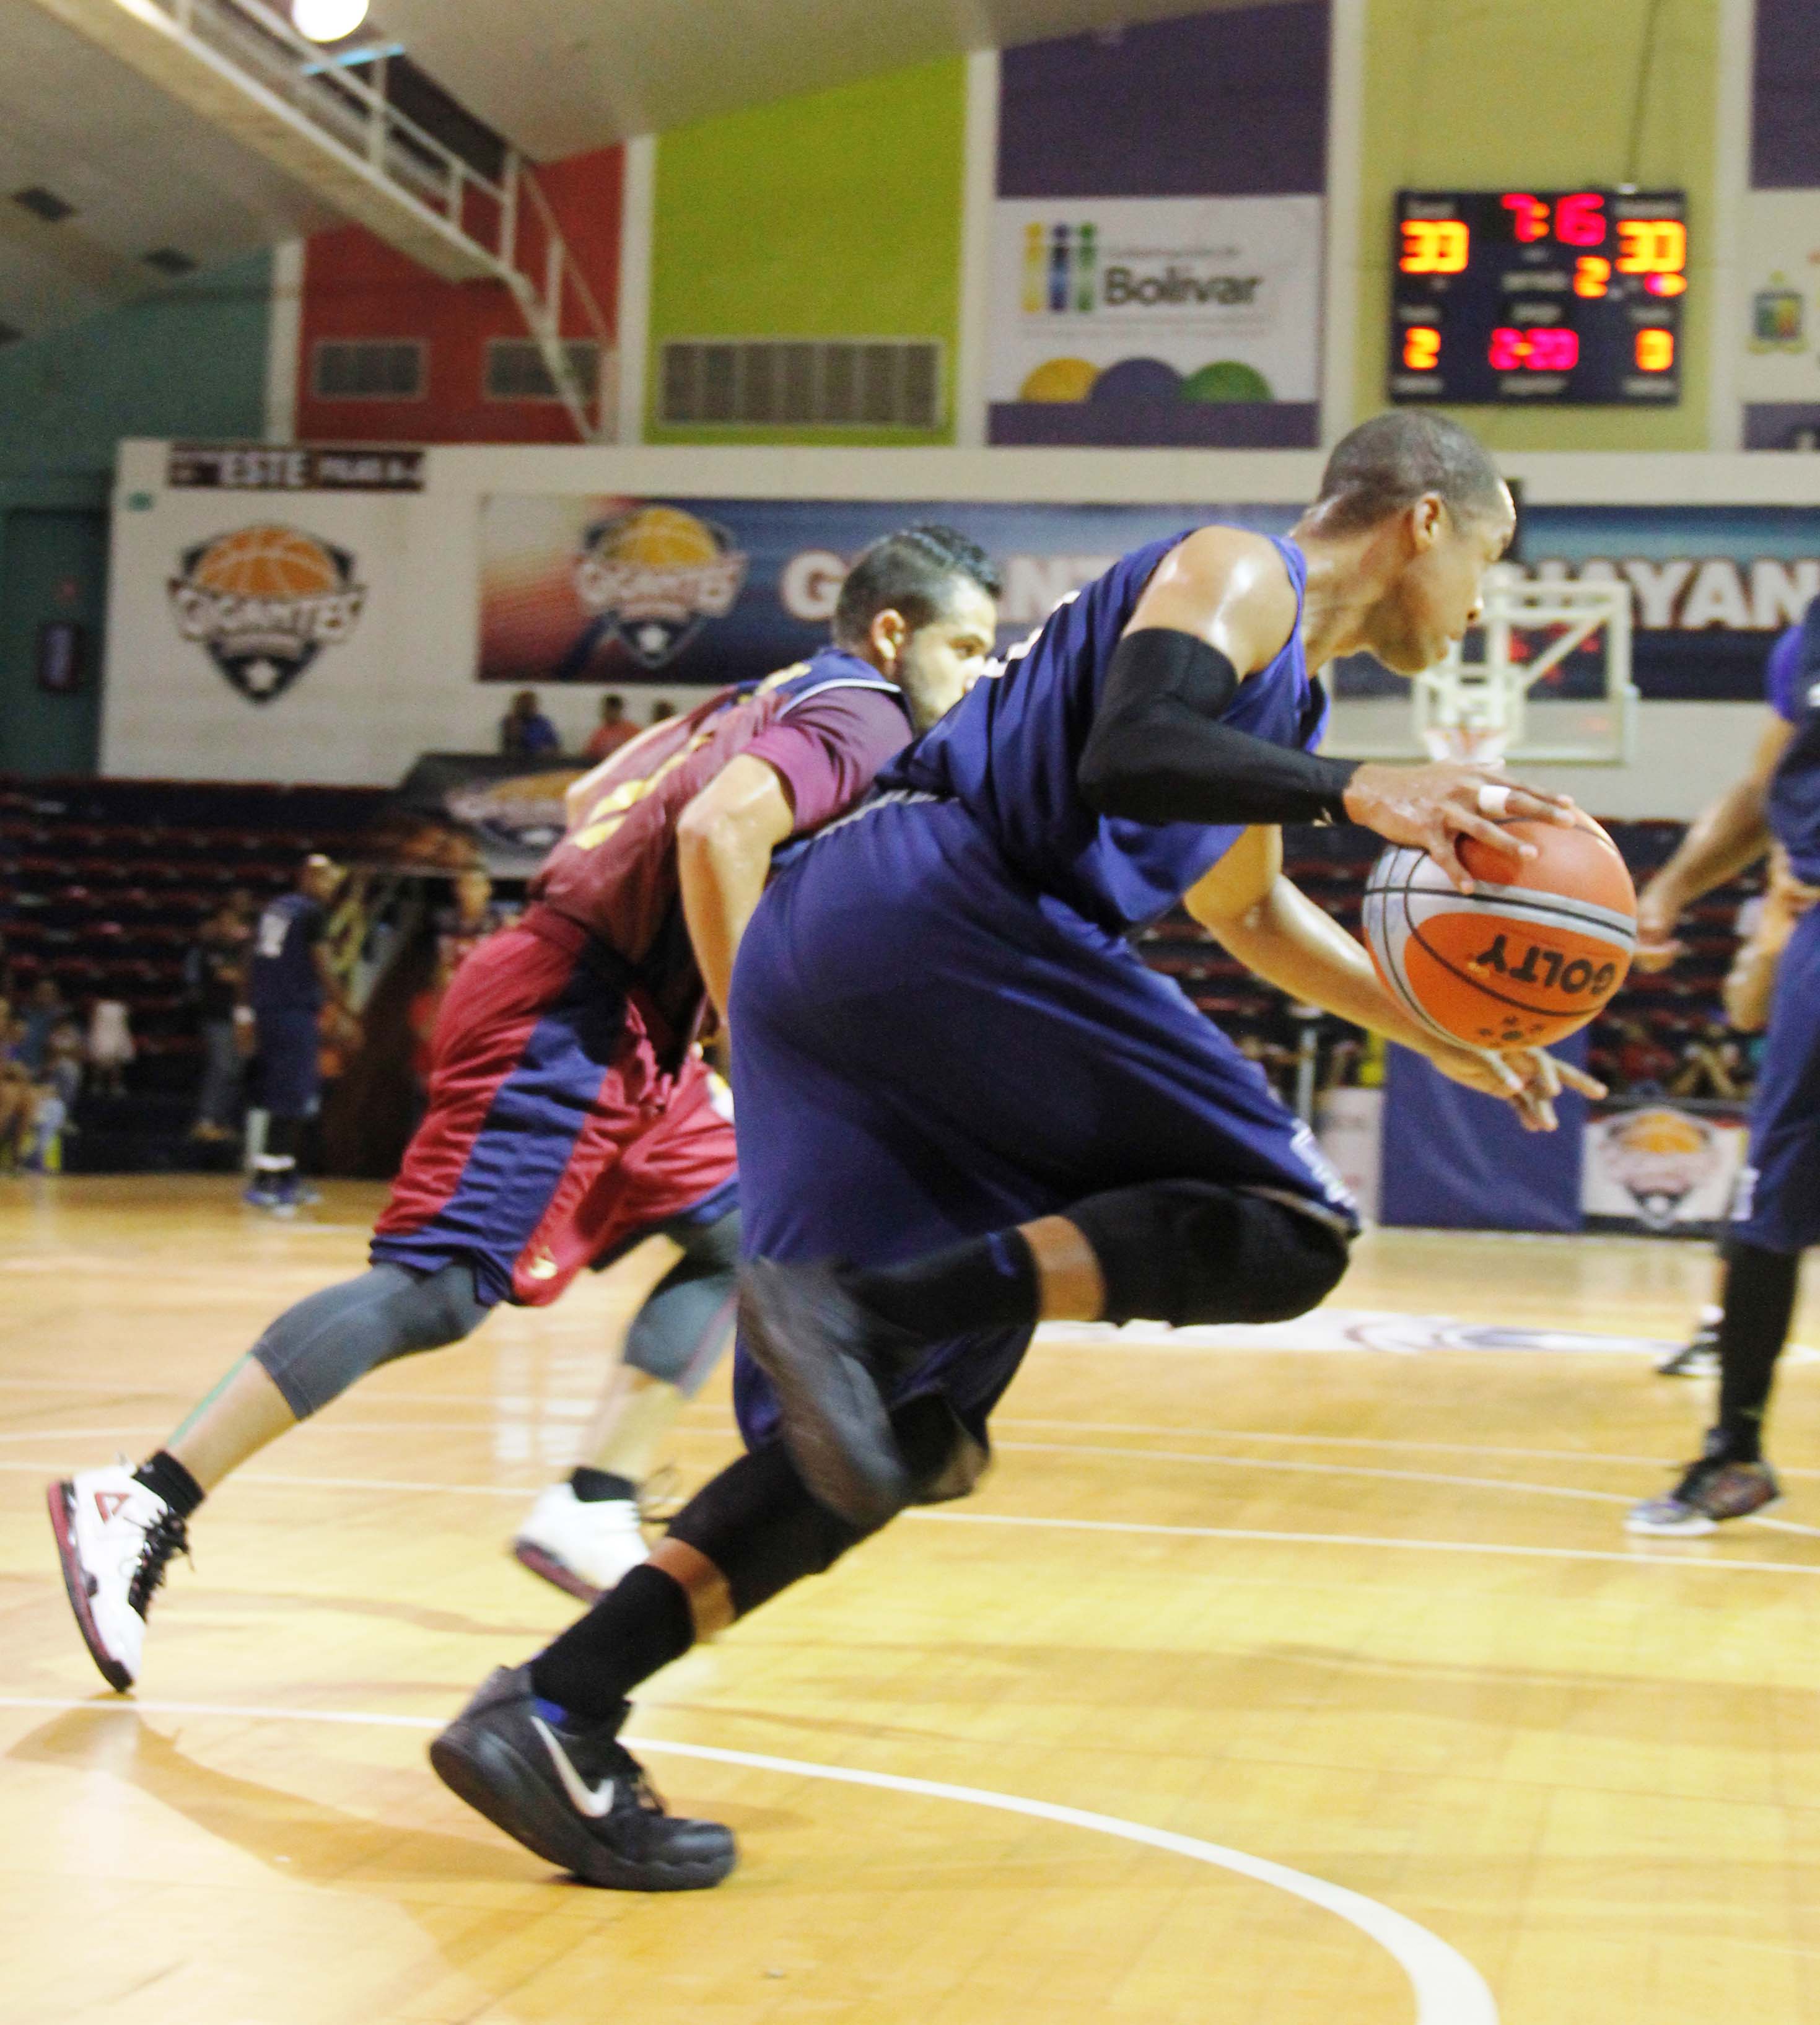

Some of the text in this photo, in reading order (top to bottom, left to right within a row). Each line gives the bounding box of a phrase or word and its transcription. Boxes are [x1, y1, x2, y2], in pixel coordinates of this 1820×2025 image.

[1573, 255, 1611, 299] 2
[1404, 326, 1442, 370] 2
[175, 585, 365, 644] GIGANTES
[1476, 934, 1616, 995] GOLTY
